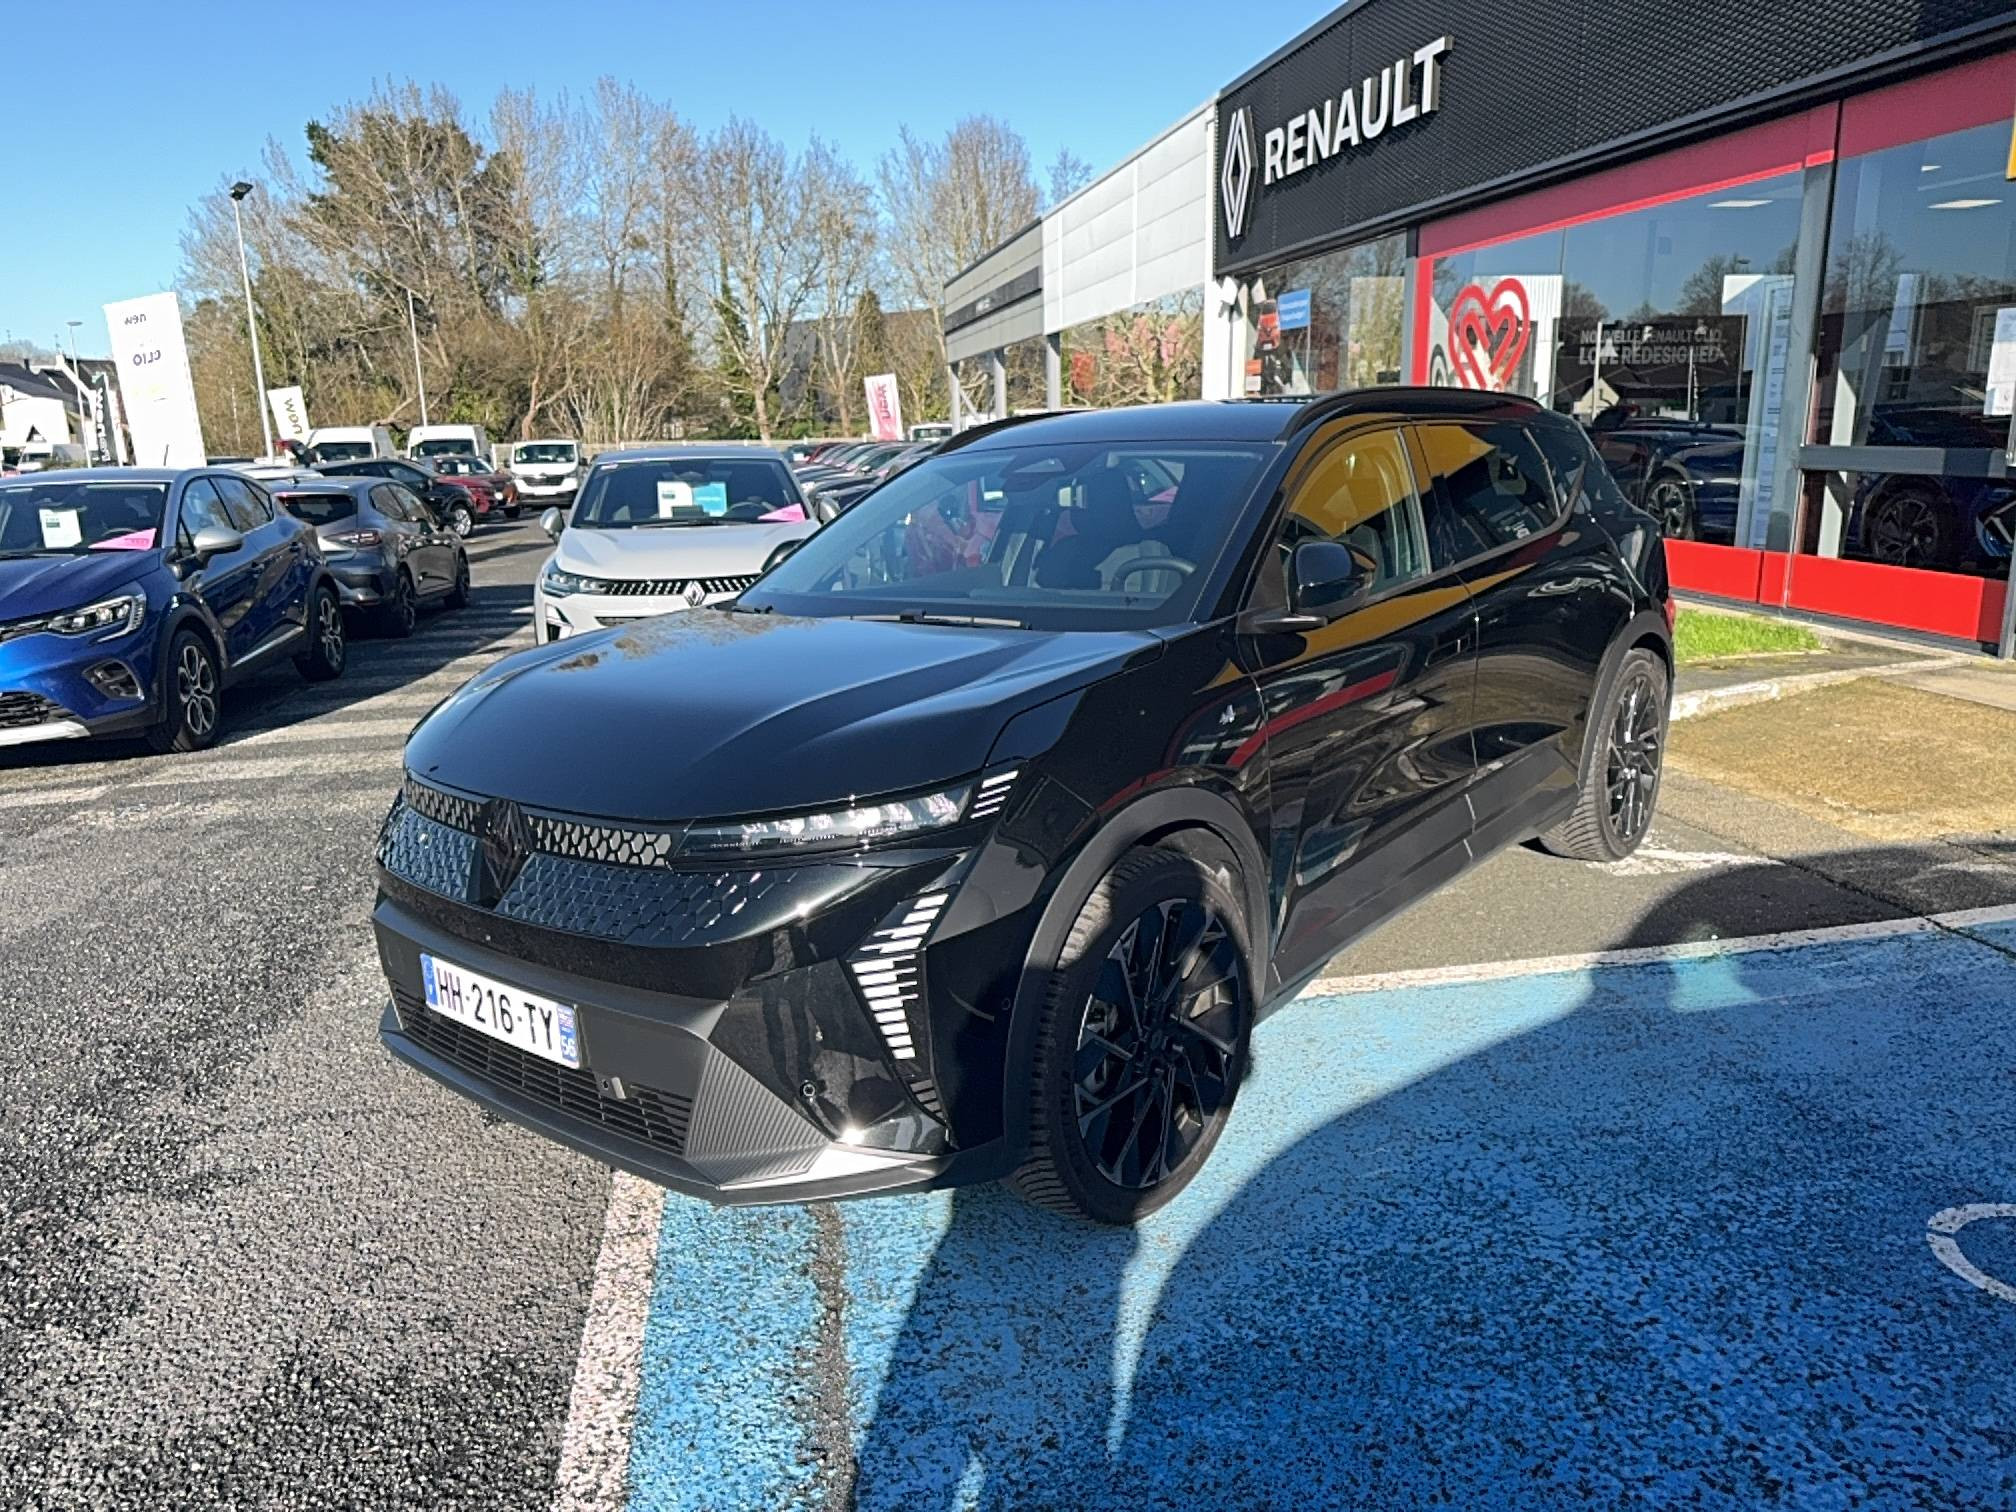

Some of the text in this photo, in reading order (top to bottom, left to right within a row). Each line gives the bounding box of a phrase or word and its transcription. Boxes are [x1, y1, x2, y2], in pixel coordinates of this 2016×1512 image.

[1265, 35, 1449, 185] RENAULT
[1643, 329, 1693, 343] ENAULT
[436, 966, 553, 1050] HH-216-TY
